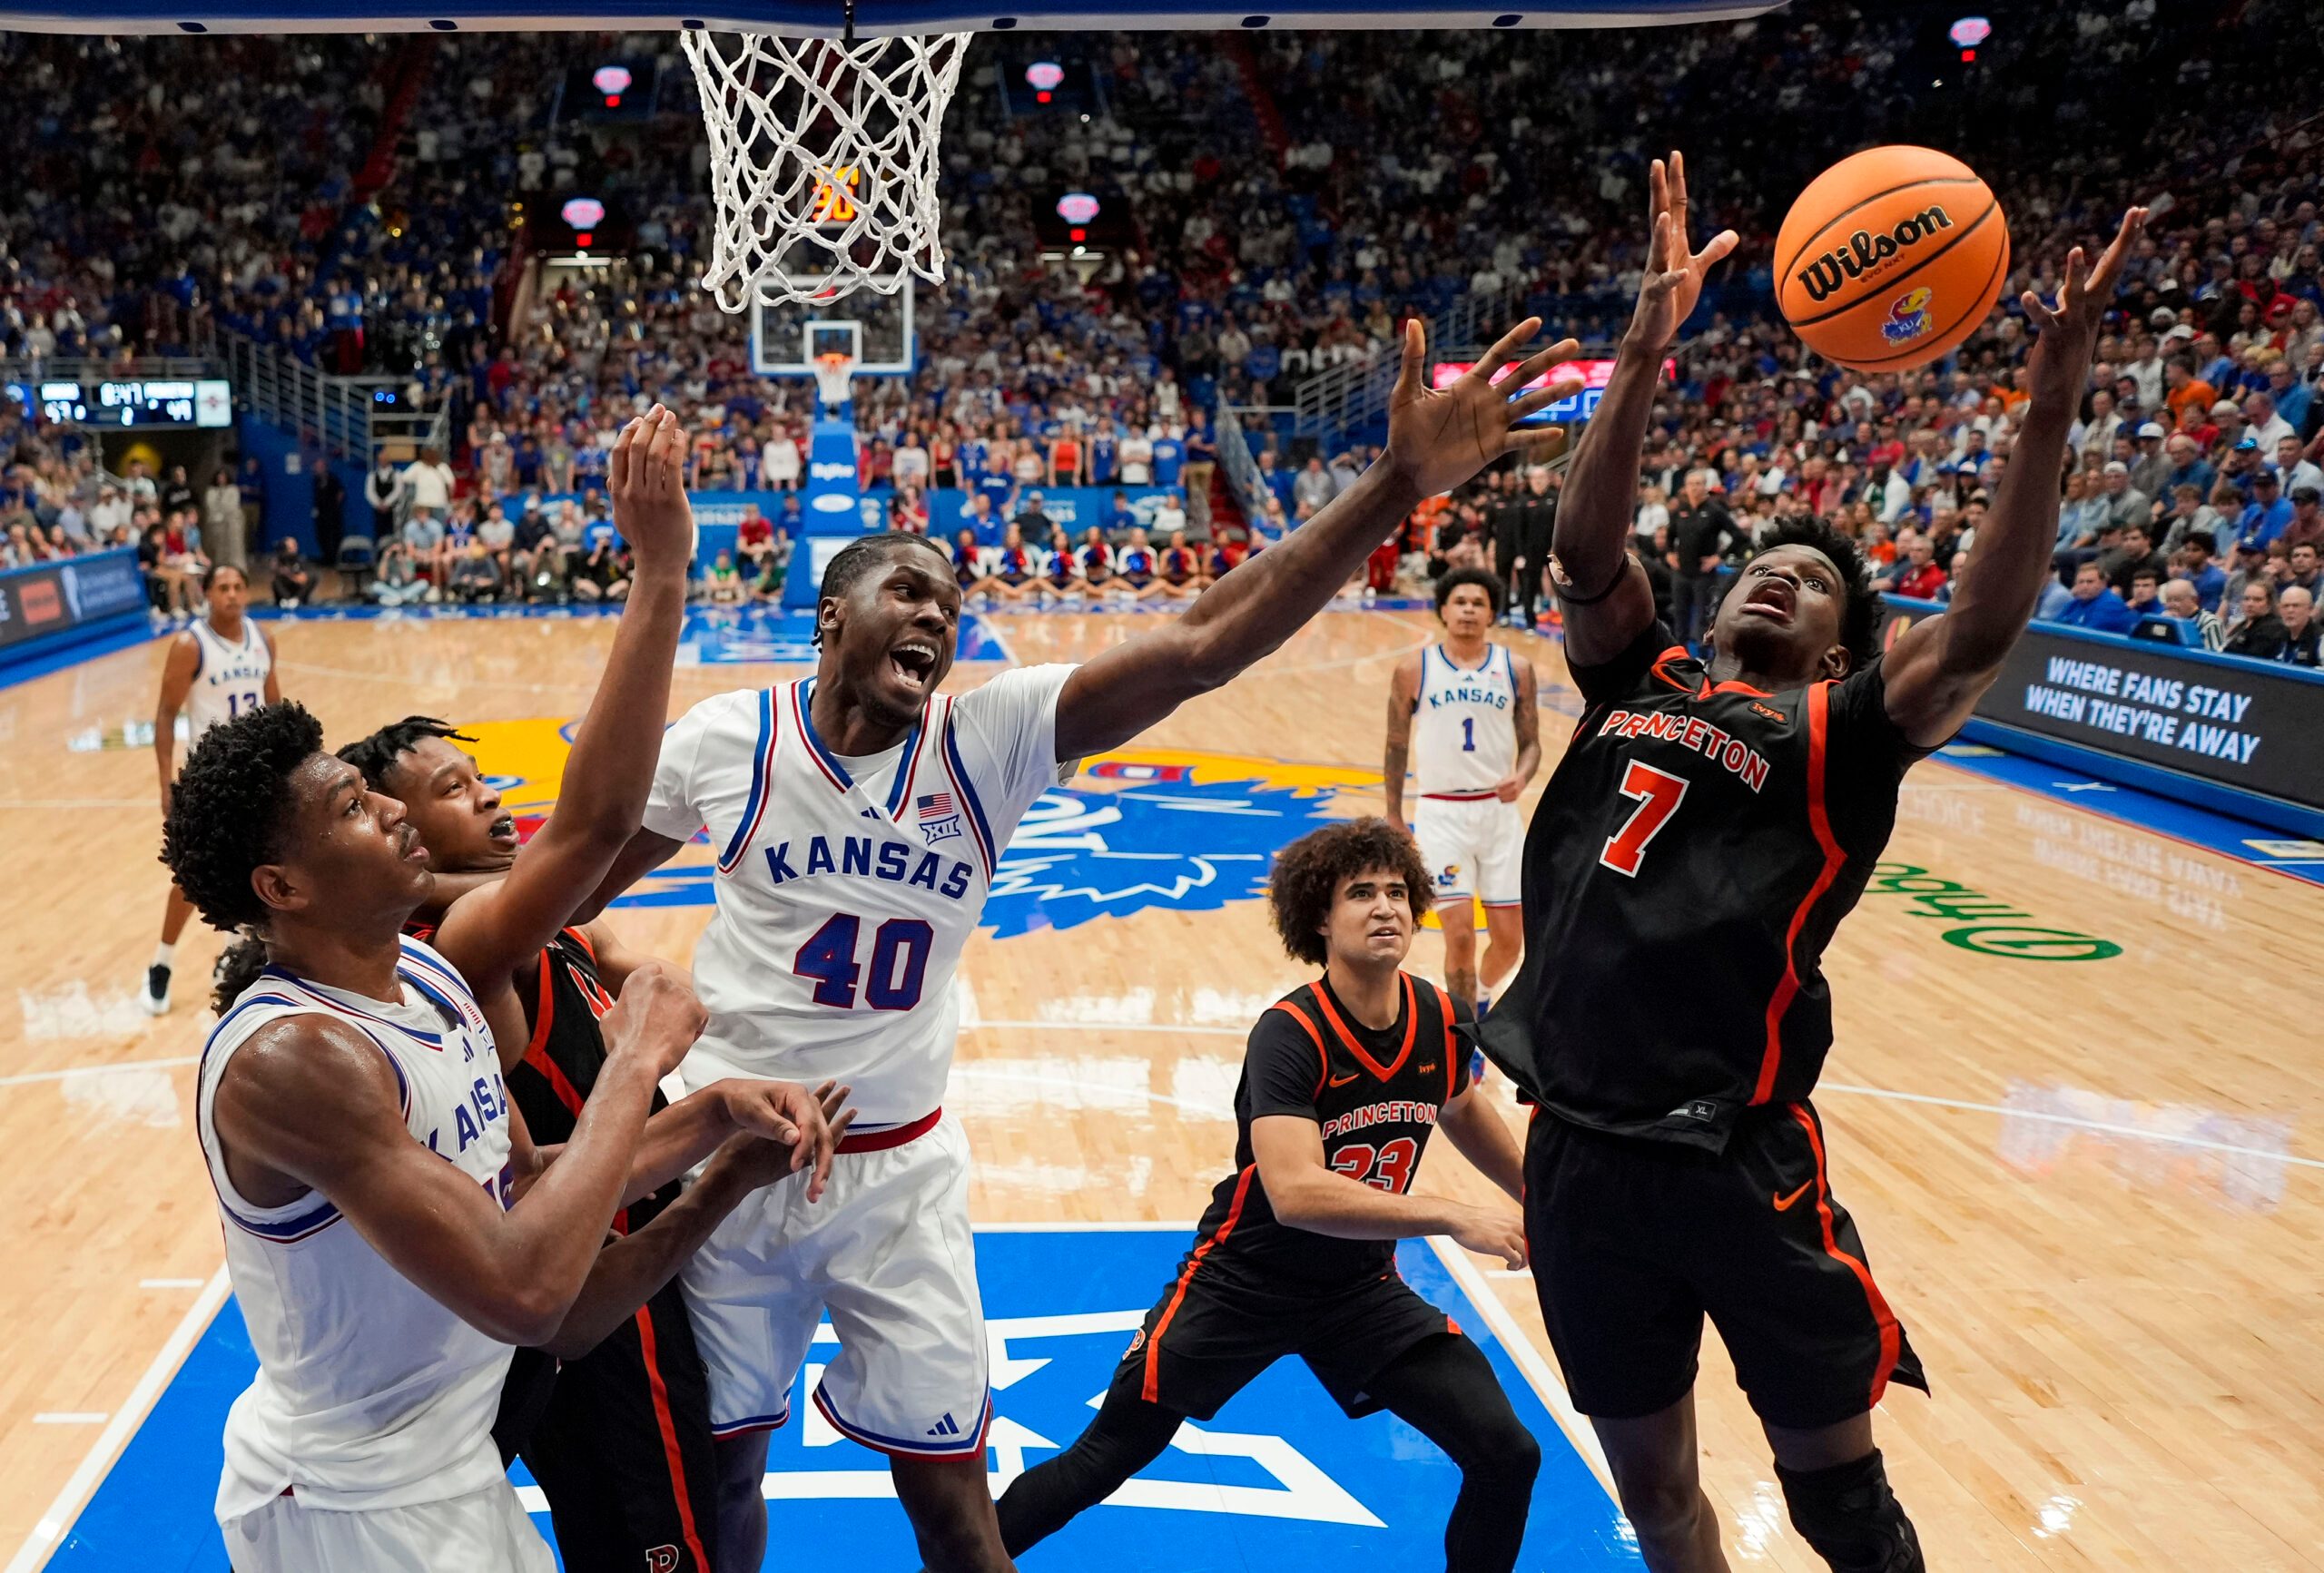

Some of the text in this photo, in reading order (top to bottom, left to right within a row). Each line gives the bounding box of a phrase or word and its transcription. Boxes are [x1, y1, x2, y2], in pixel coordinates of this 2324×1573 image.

[1797, 205, 1954, 302] Wilson
[1860, 253, 1905, 283] EVO NXT
[1898, 320, 1915, 333] KU
[1428, 687, 1508, 711] KANSAS
[2047, 656, 2252, 723] WHERE FANS STAY
[1462, 717, 1475, 752] 1
[2024, 684, 2260, 764] WHEN THEY'RE AWAY
[1598, 710, 1770, 794] PRNCETON
[919, 813, 962, 846] XII
[1598, 758, 1690, 879] 7
[764, 835, 973, 900] KANSAS
[793, 912, 934, 1011] 40
[1322, 1101, 1438, 1141] PRINCETON
[1695, 1105, 1708, 1116] XL
[1331, 1136, 1418, 1195] 23
[645, 1544, 679, 1573] P
